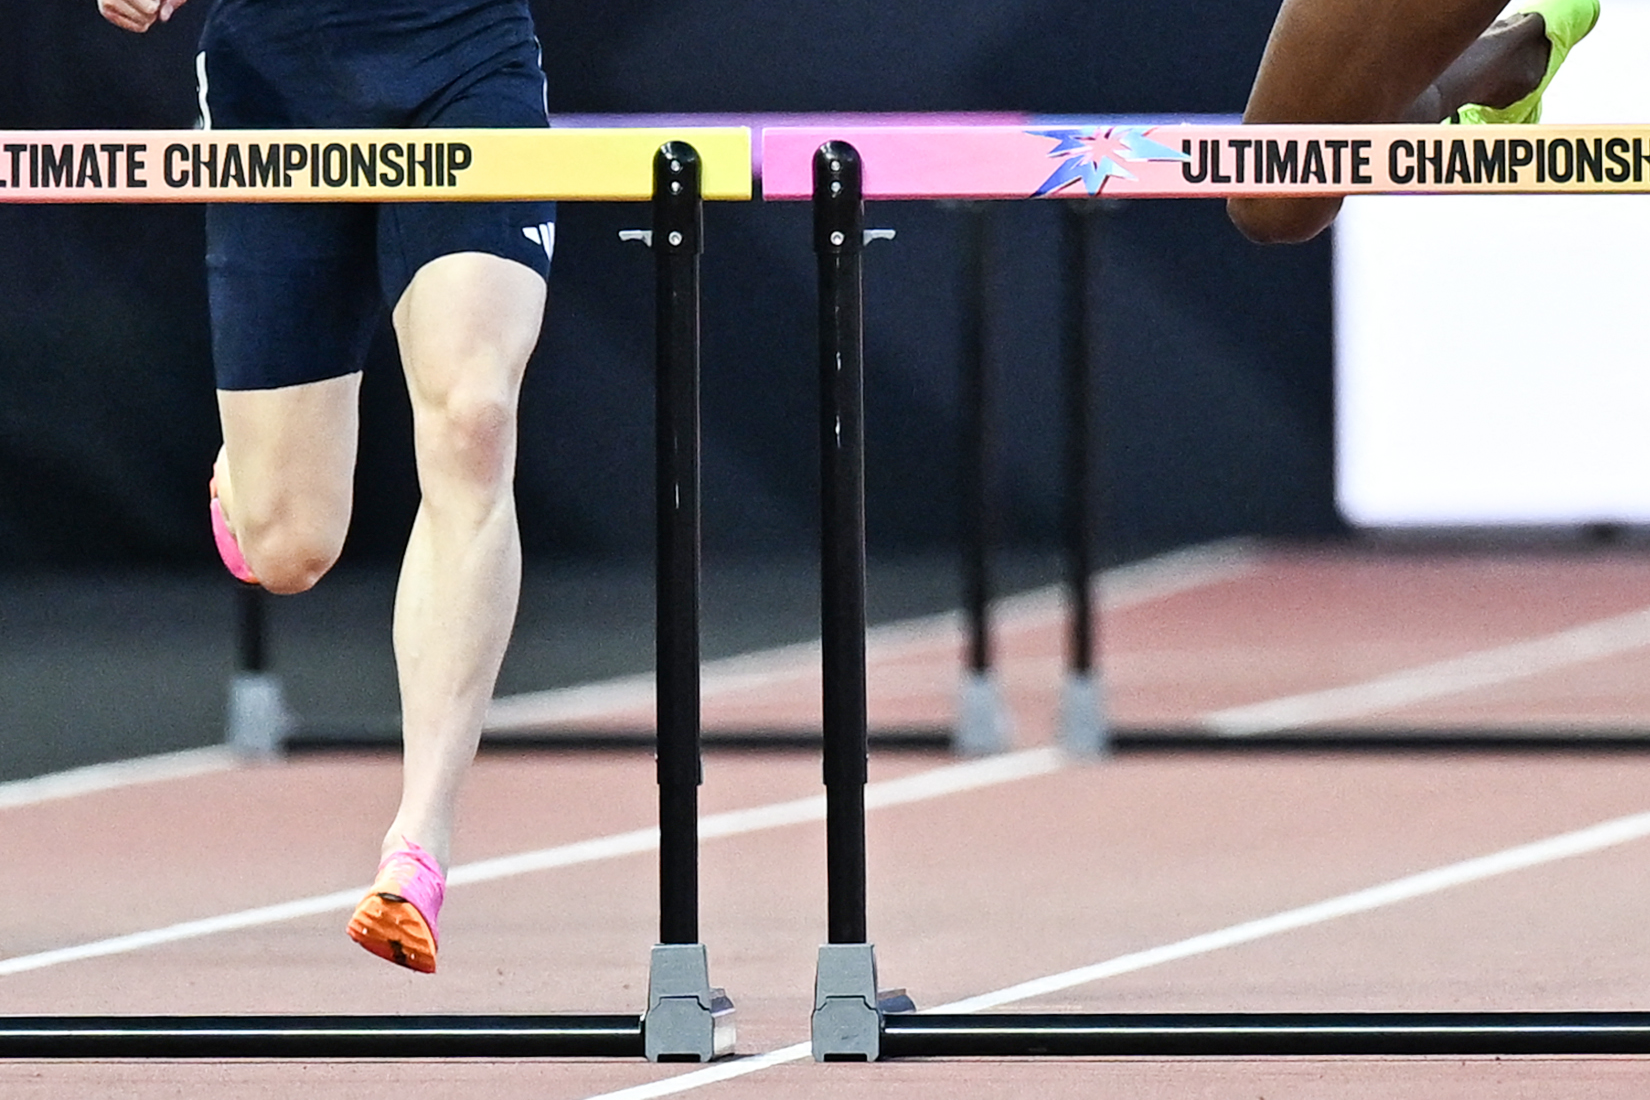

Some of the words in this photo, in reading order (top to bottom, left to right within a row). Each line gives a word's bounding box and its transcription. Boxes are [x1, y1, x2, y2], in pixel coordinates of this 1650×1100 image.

[0, 143, 147, 188] TIMATE
[163, 142, 472, 188] CHAMPIONSHIP
[1182, 139, 1372, 184] ULTIMATE
